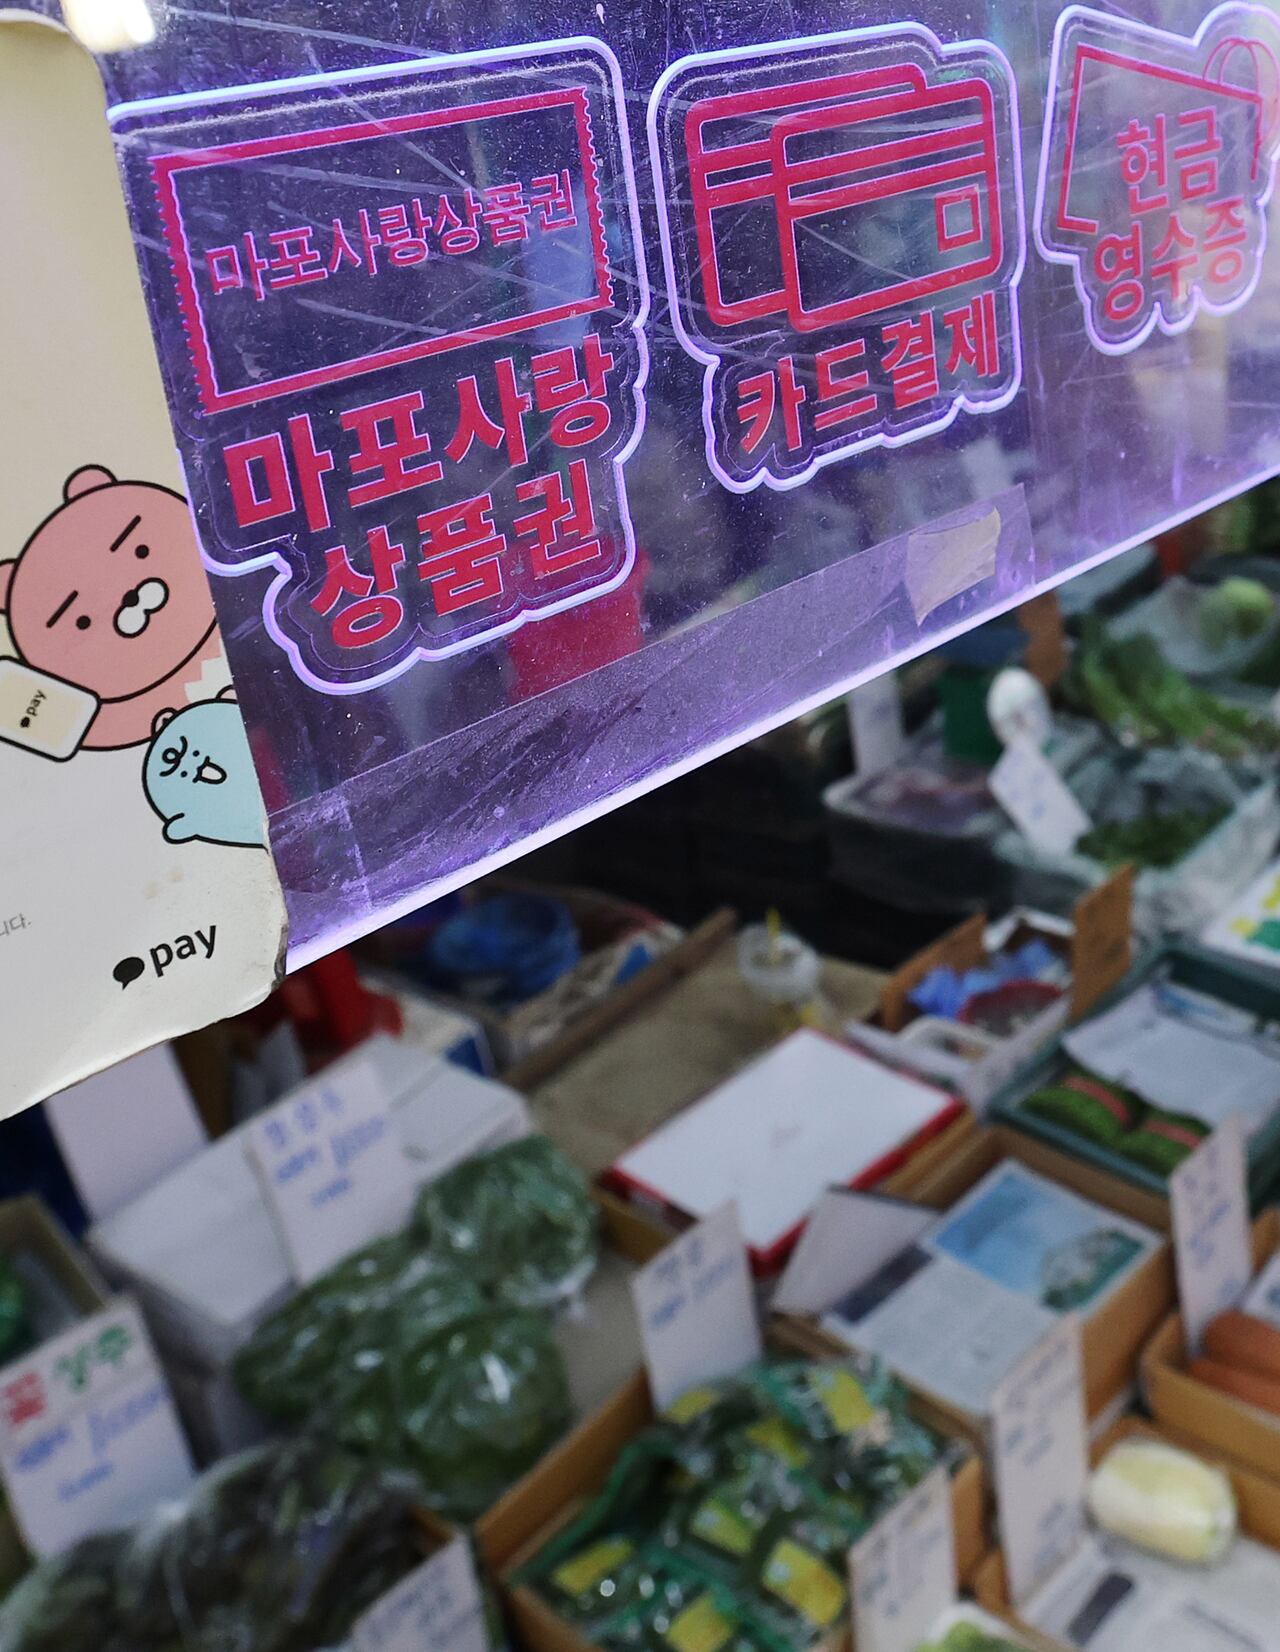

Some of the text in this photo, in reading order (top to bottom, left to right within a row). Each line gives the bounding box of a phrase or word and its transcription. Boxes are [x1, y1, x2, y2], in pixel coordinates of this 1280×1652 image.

[1116, 106, 1222, 215] 현금
[207, 169, 577, 300] 마포사랑상품권
[1095, 199, 1247, 321] 영수증
[222, 335, 613, 532] 마포사랑
[738, 293, 999, 453] 카드결제
[310, 461, 601, 648] 상품권
[26, 689, 47, 717] pay
[149, 925, 216, 978] pay
